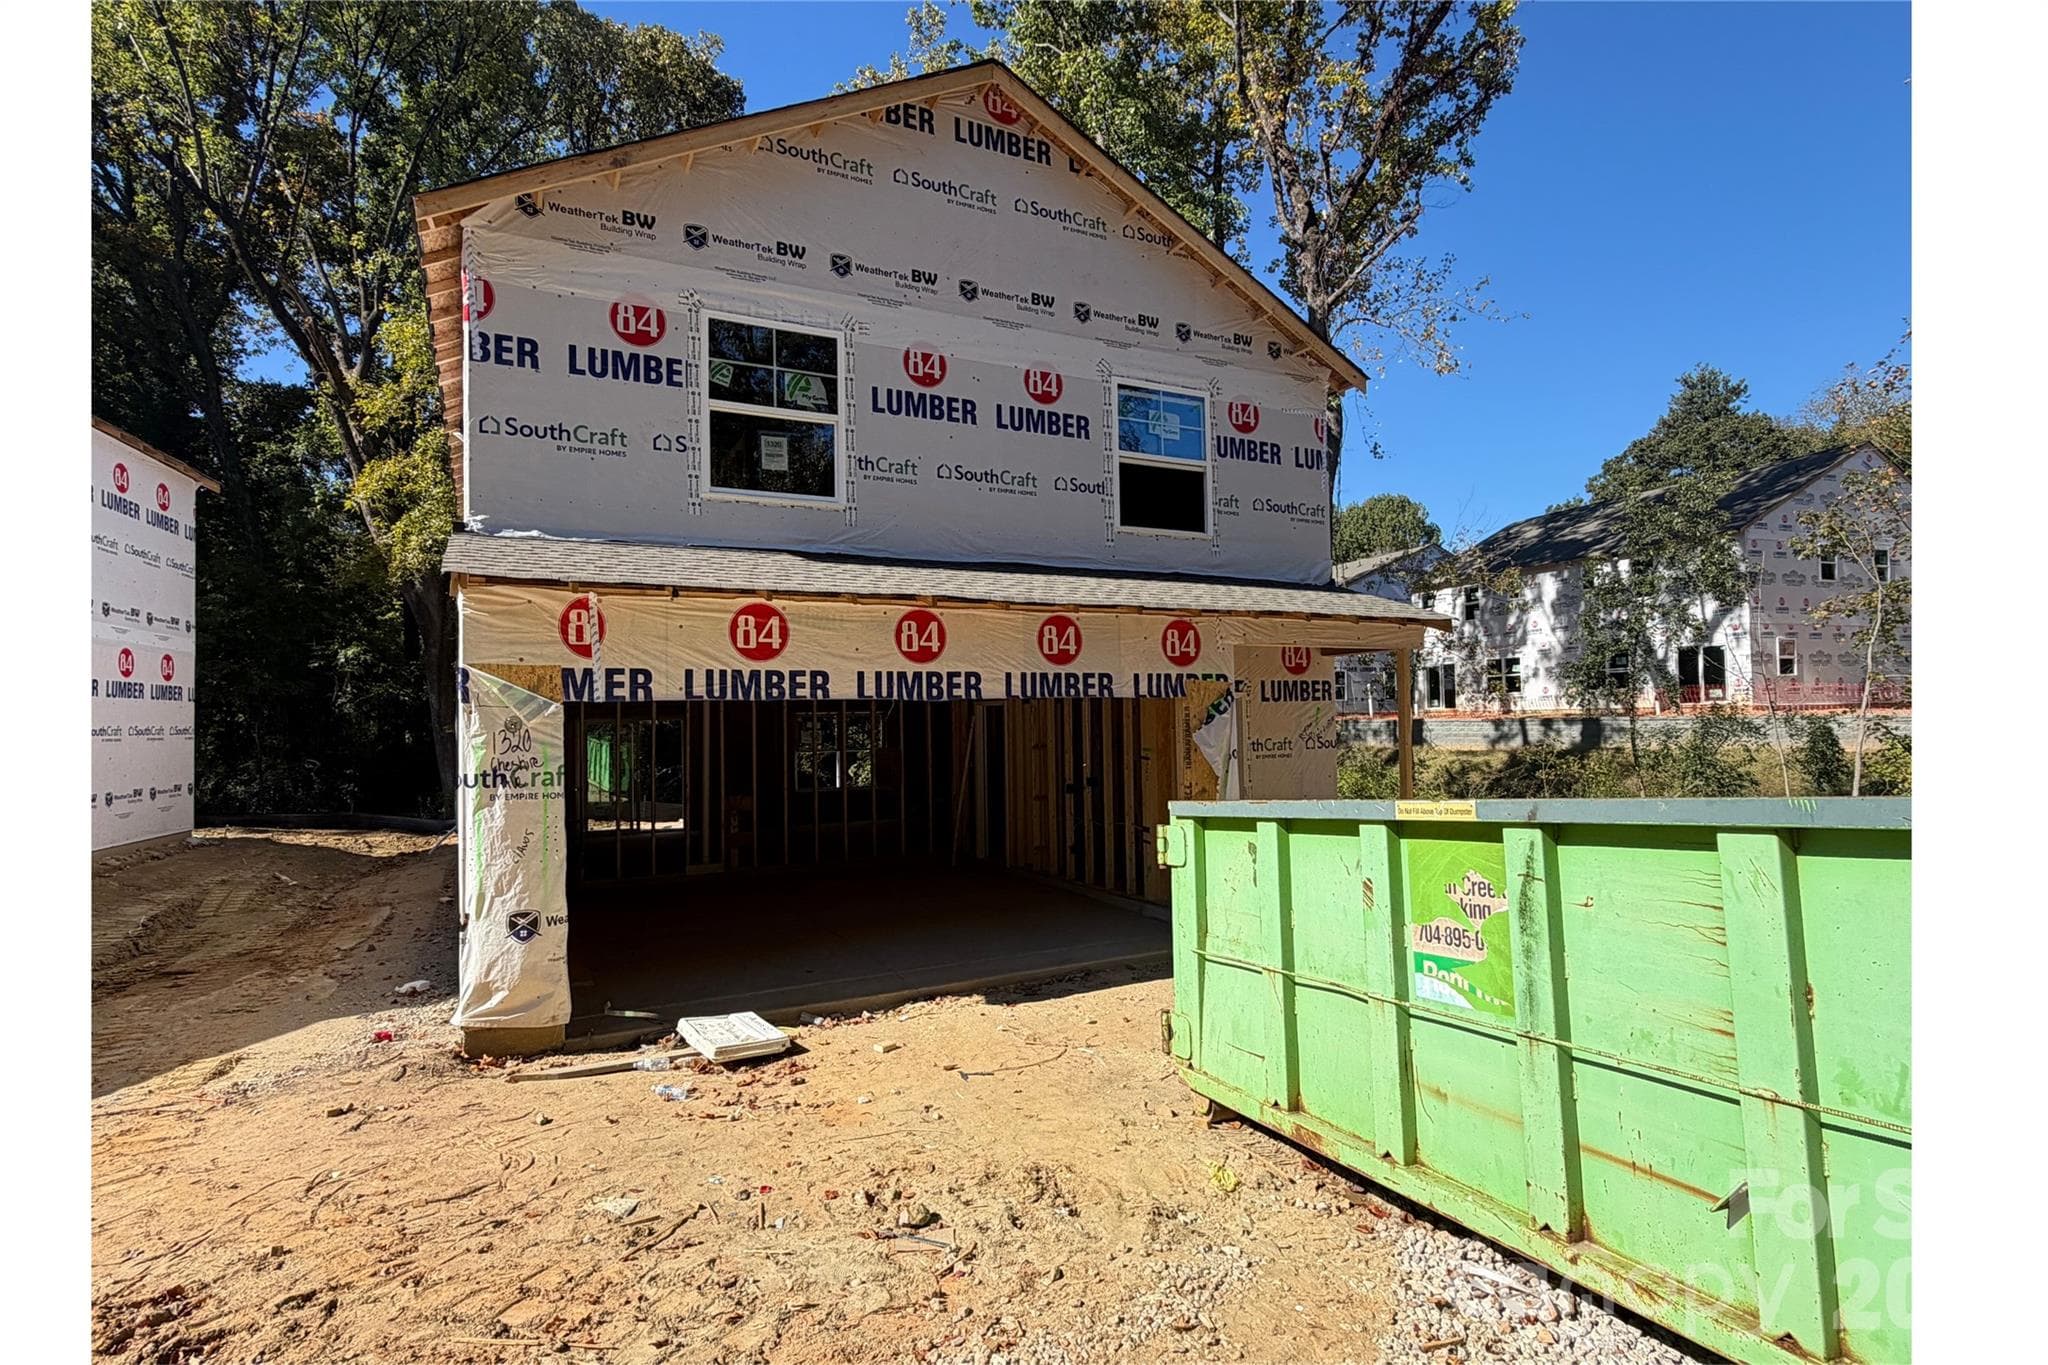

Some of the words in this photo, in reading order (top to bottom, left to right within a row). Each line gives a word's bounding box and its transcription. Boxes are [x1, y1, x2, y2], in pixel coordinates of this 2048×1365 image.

[954, 116, 1052, 167] LUMBER
[776, 138, 875, 177] SouthCraft
[827, 168, 849, 180] EMPIRE
[850, 174, 873, 185] HOMES
[911, 171, 997, 207] SouthCraft
[548, 200, 619, 225] WeatherTek
[621, 209, 657, 230] BW
[955, 200, 976, 210] EMPIRE
[976, 206, 997, 215] HOMES
[1030, 201, 1108, 233] SouthCraft
[600, 223, 633, 238] Building
[634, 230, 657, 242] Wrap
[711, 233, 774, 255] WeatherTek
[775, 240, 807, 260] BW
[757, 252, 786, 267] Building
[787, 260, 807, 271] Wrap
[855, 262, 909, 282] WeatherTek
[911, 269, 938, 287] BW
[895, 280, 920, 294] Building
[980, 287, 1030, 304] WeatherTek
[1031, 292, 1055, 309] BW
[616, 303, 660, 338] 84
[1093, 309, 1137, 325] WeatherTek
[1138, 313, 1159, 330] BW
[567, 343, 688, 389] LUMBE
[908, 350, 942, 379] 84
[1028, 368, 1059, 397] 84
[871, 386, 978, 426] LUMBER
[995, 403, 1091, 441] LUMBER
[1231, 402, 1256, 428] 84
[504, 416, 628, 448] SouthCraft
[568, 446, 597, 456] EMPIRE
[598, 449, 628, 458] HOMES
[114, 467, 128, 488] 84
[872, 476, 894, 484] EMPIRE
[895, 478, 918, 486] HOMES
[954, 464, 1037, 488] SouthCraft
[101, 489, 140, 521] LUMBER
[146, 508, 180, 536] LUMBER
[1265, 499, 1326, 519] SouthCraft
[736, 614, 782, 650] 84
[900, 619, 941, 654] 84
[1043, 625, 1078, 657] 84
[1167, 628, 1197, 658] 84
[119, 653, 133, 672] 84
[1284, 646, 1308, 668] 84
[106, 680, 145, 700] LUMBER
[150, 684, 183, 701] LUMBER
[684, 668, 831, 701] LUMBER
[856, 670, 983, 700] LUMBER
[1004, 671, 1114, 699] LUMBER
[1260, 679, 1332, 702] LUMBER
[493, 728, 532, 755] 1320
[489, 793, 502, 801] BY
[505, 792, 539, 801] EMPIRE
[1462, 876, 1506, 899] Cree
